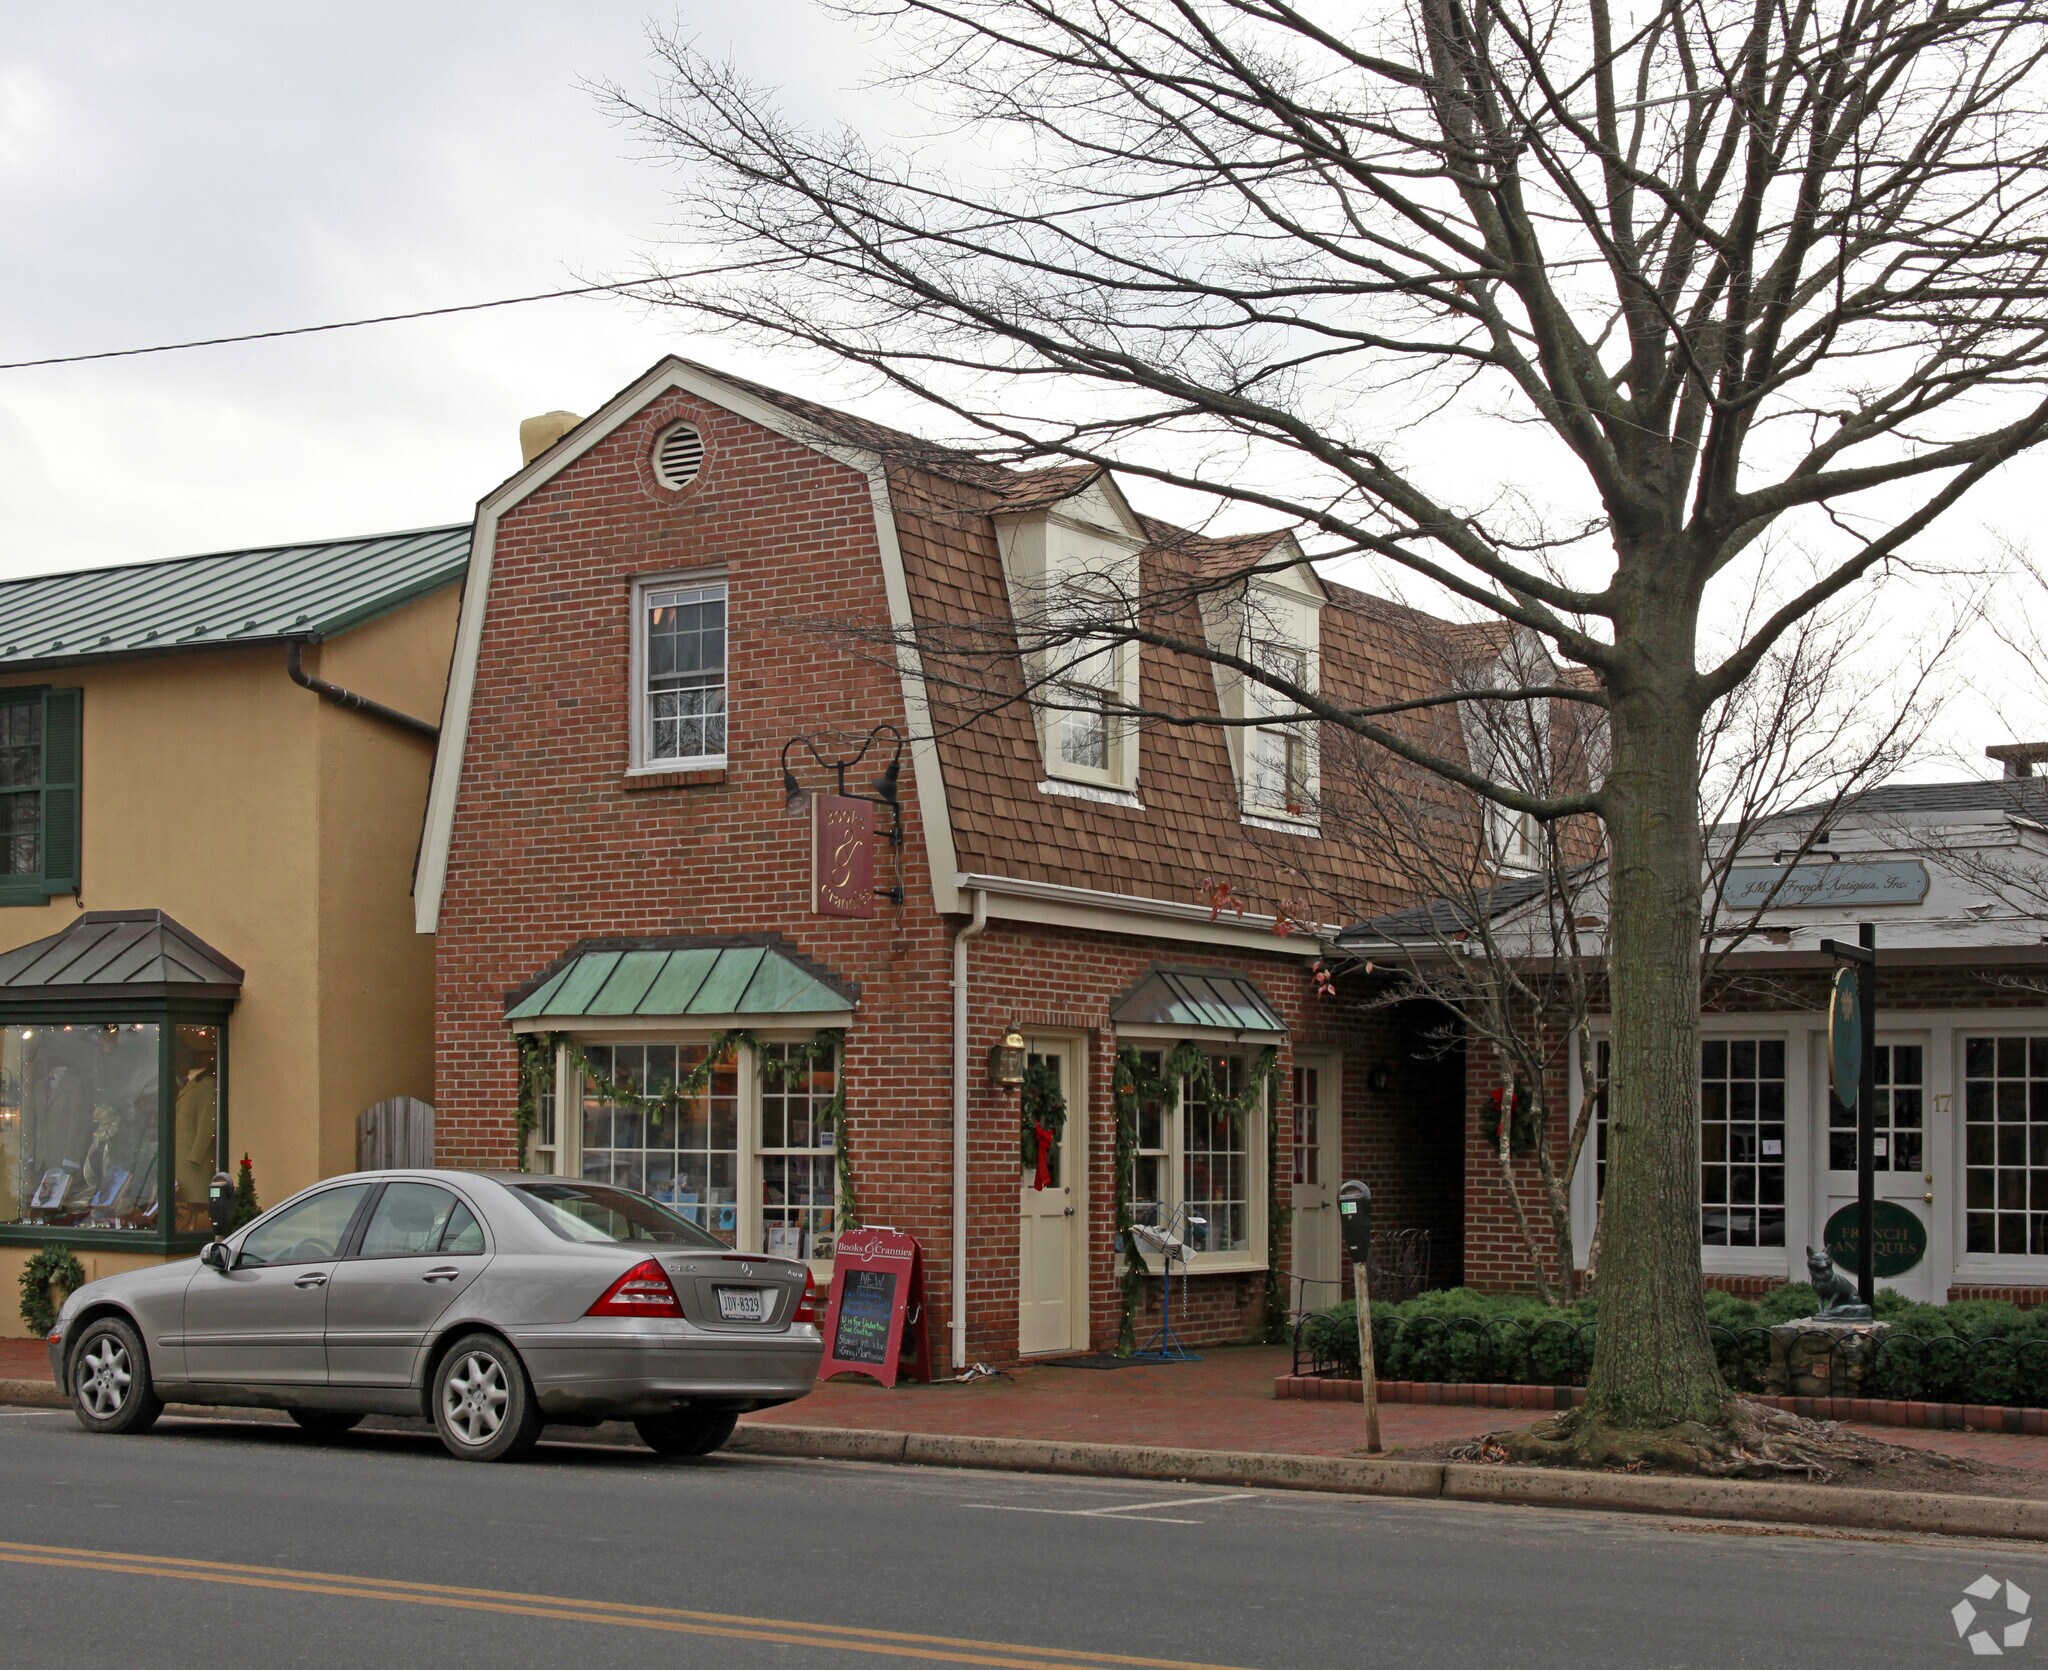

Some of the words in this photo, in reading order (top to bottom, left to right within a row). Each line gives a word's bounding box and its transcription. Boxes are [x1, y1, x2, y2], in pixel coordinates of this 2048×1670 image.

[1933, 1093, 1952, 1113] 17
[1841, 1227, 1908, 1240] FRNCH
[838, 1242, 863, 1252] Books
[861, 1236, 883, 1263] &
[875, 1245, 912, 1257] Crannies
[1834, 1241, 1918, 1257] ANQUES
[859, 1272, 885, 1287] NEW
[724, 1296, 759, 1312] JDV-8329
